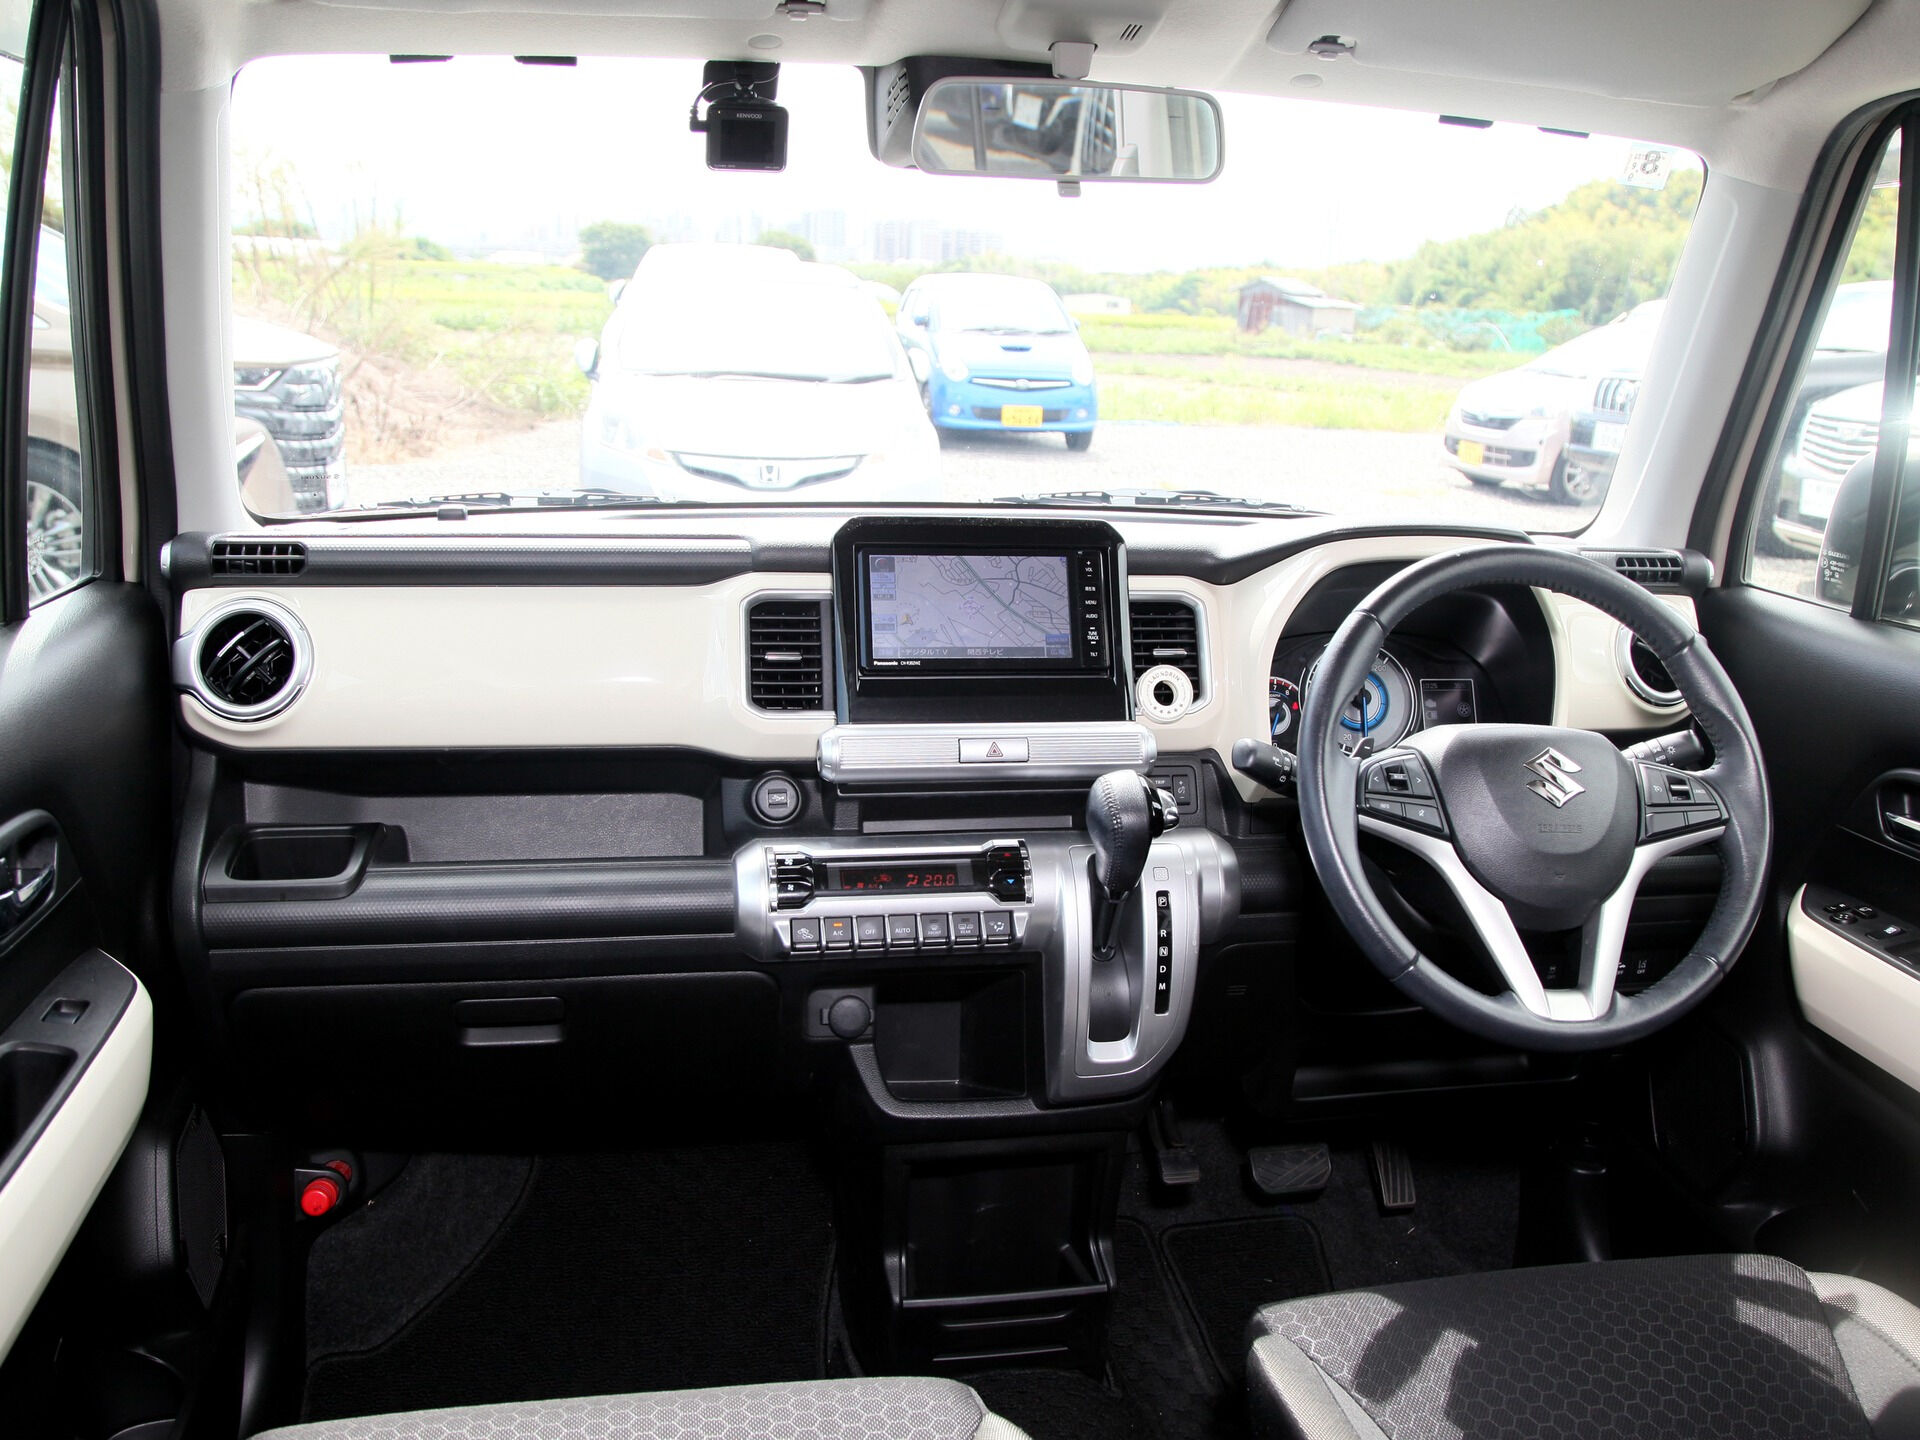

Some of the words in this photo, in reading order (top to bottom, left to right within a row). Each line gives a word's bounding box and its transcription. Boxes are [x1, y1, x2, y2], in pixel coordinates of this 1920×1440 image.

[1640, 151, 1661, 174] 8
[923, 873, 956, 887] 20.0
[1160, 929, 1167, 937] R
[1159, 965, 1167, 973] D
[1158, 982, 1166, 990] M
